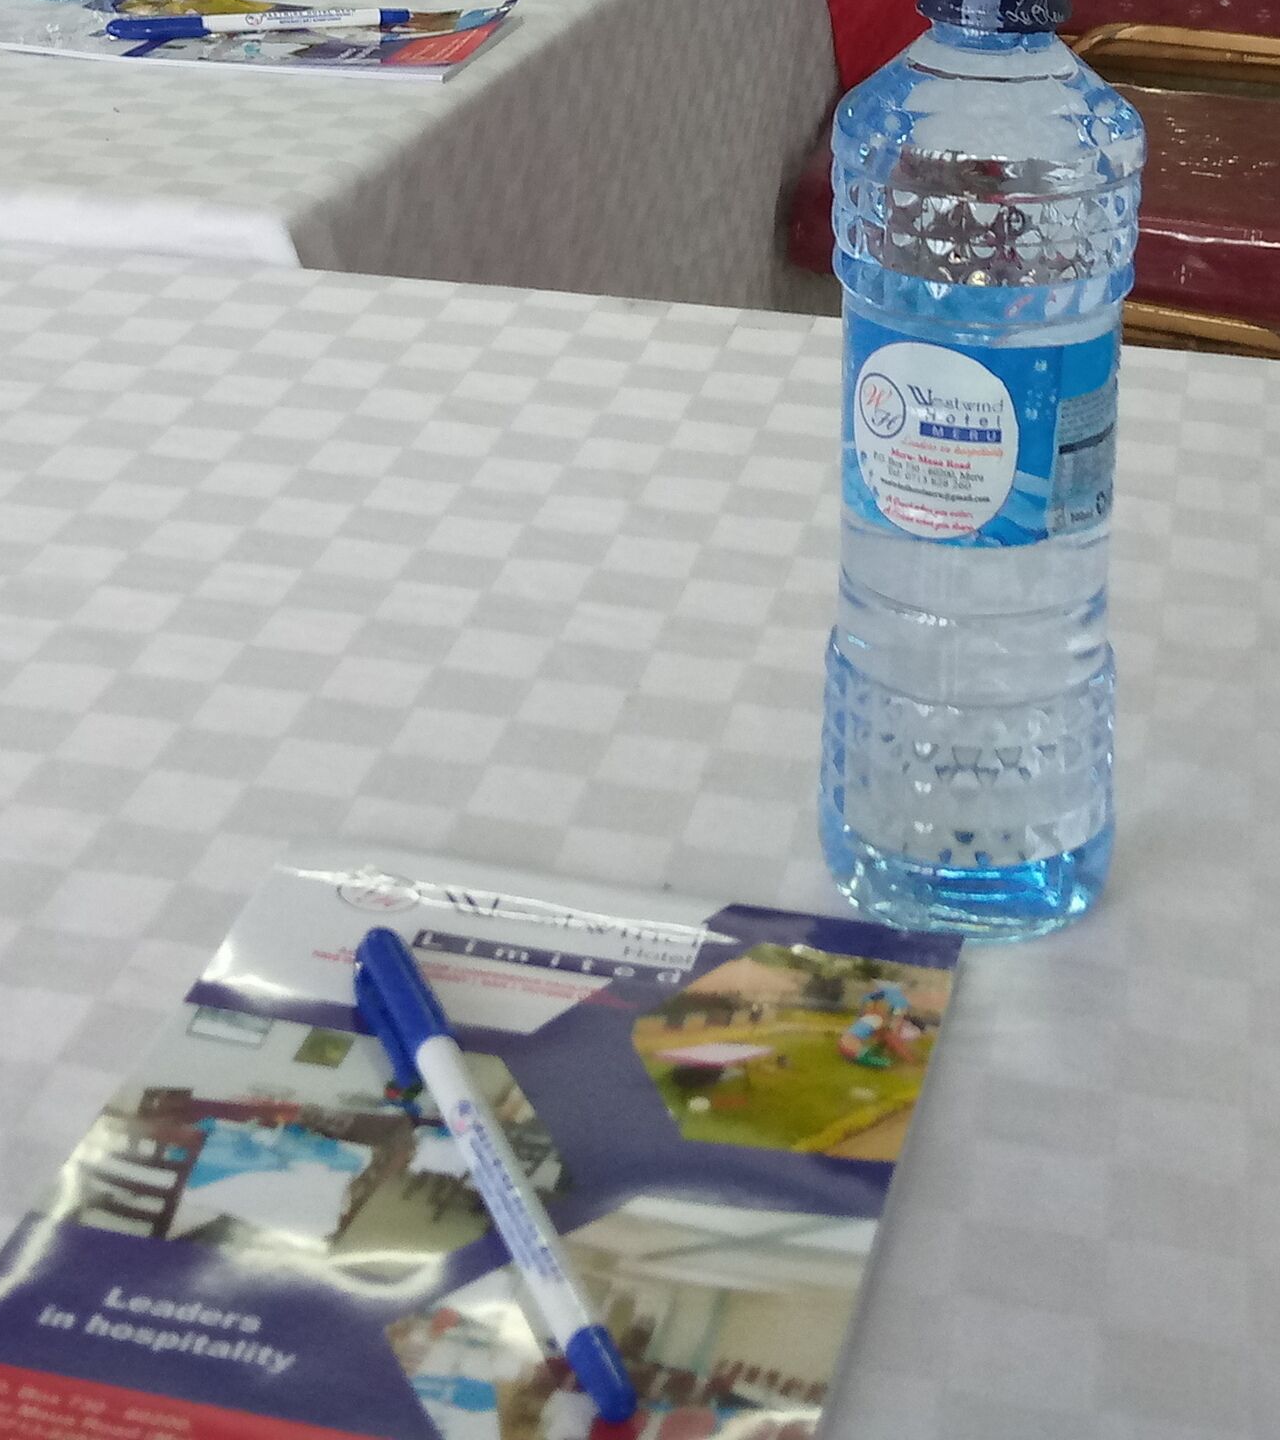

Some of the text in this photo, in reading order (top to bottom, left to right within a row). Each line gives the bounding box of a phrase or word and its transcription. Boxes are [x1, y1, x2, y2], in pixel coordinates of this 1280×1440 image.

[907, 384, 1004, 413] Westwind
[931, 425, 998, 443] MERU
[422, 931, 682, 985] Limited
[103, 1286, 261, 1334] Leaders
[85, 1312, 296, 1375] hospitality
